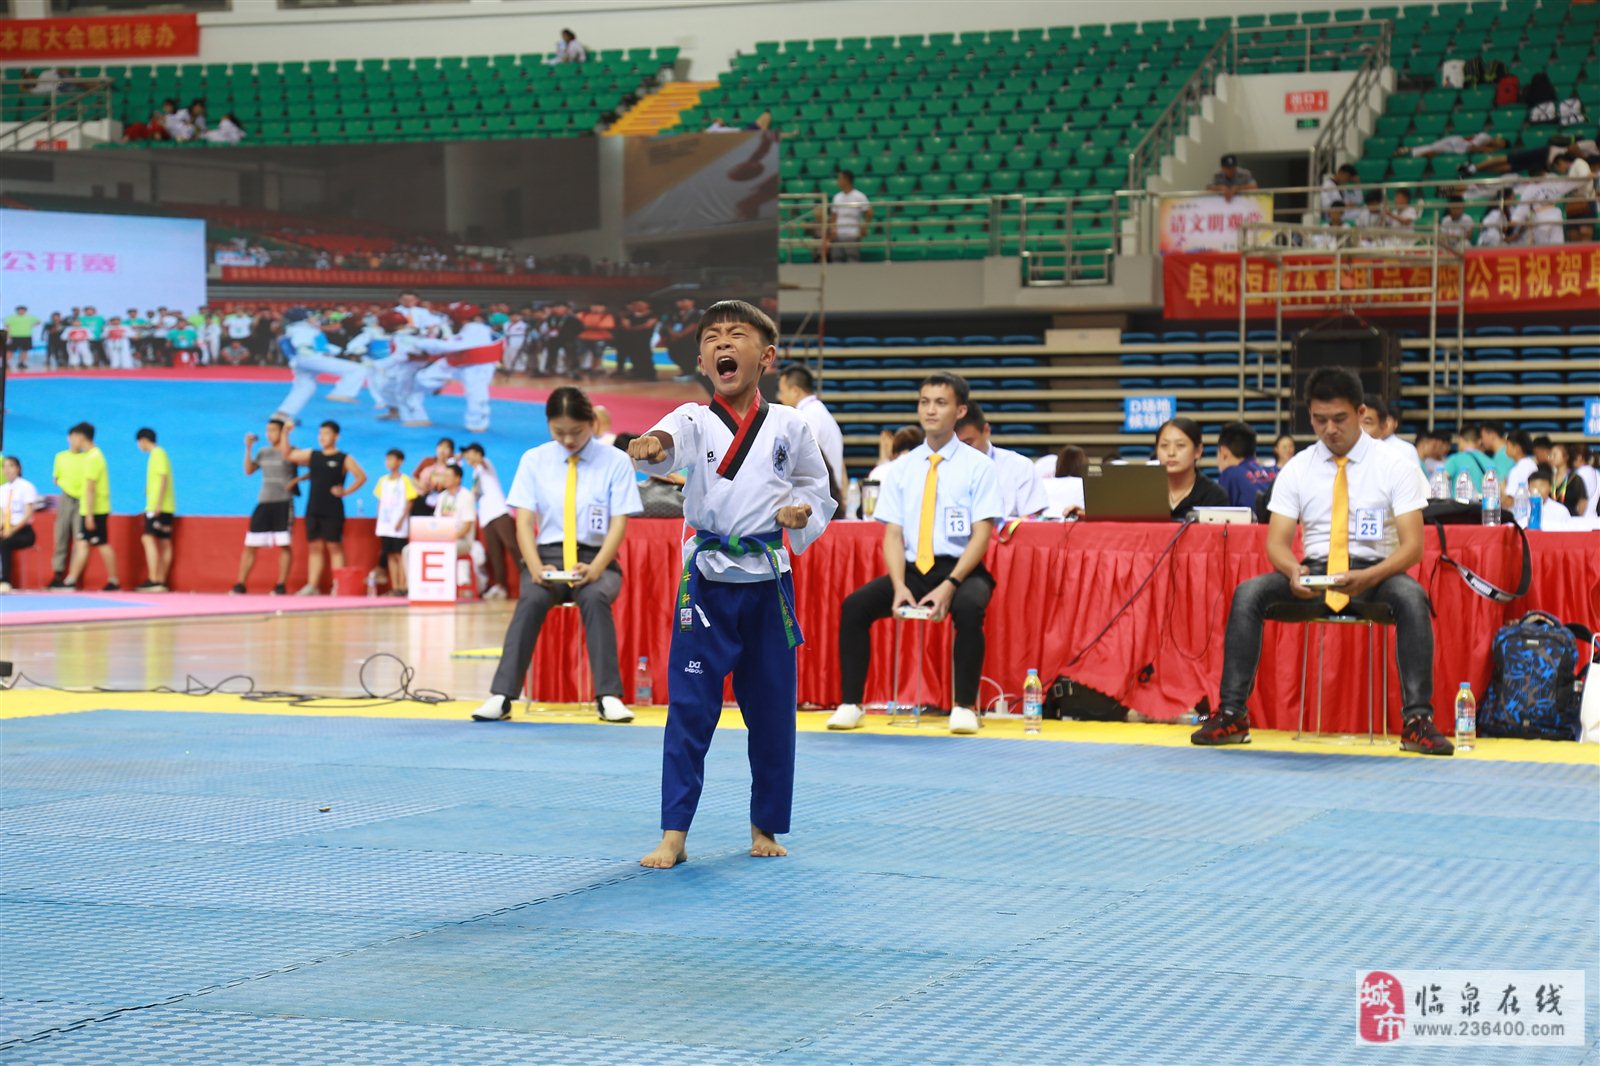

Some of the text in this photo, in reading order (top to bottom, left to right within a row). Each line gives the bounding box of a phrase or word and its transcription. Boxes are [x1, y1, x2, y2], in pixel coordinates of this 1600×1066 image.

[2, 250, 117, 273] 公开赛
[591, 518, 603, 530] 12
[950, 519, 965, 532] 13
[1360, 522, 1378, 536] 25
[421, 550, 446, 583] E
